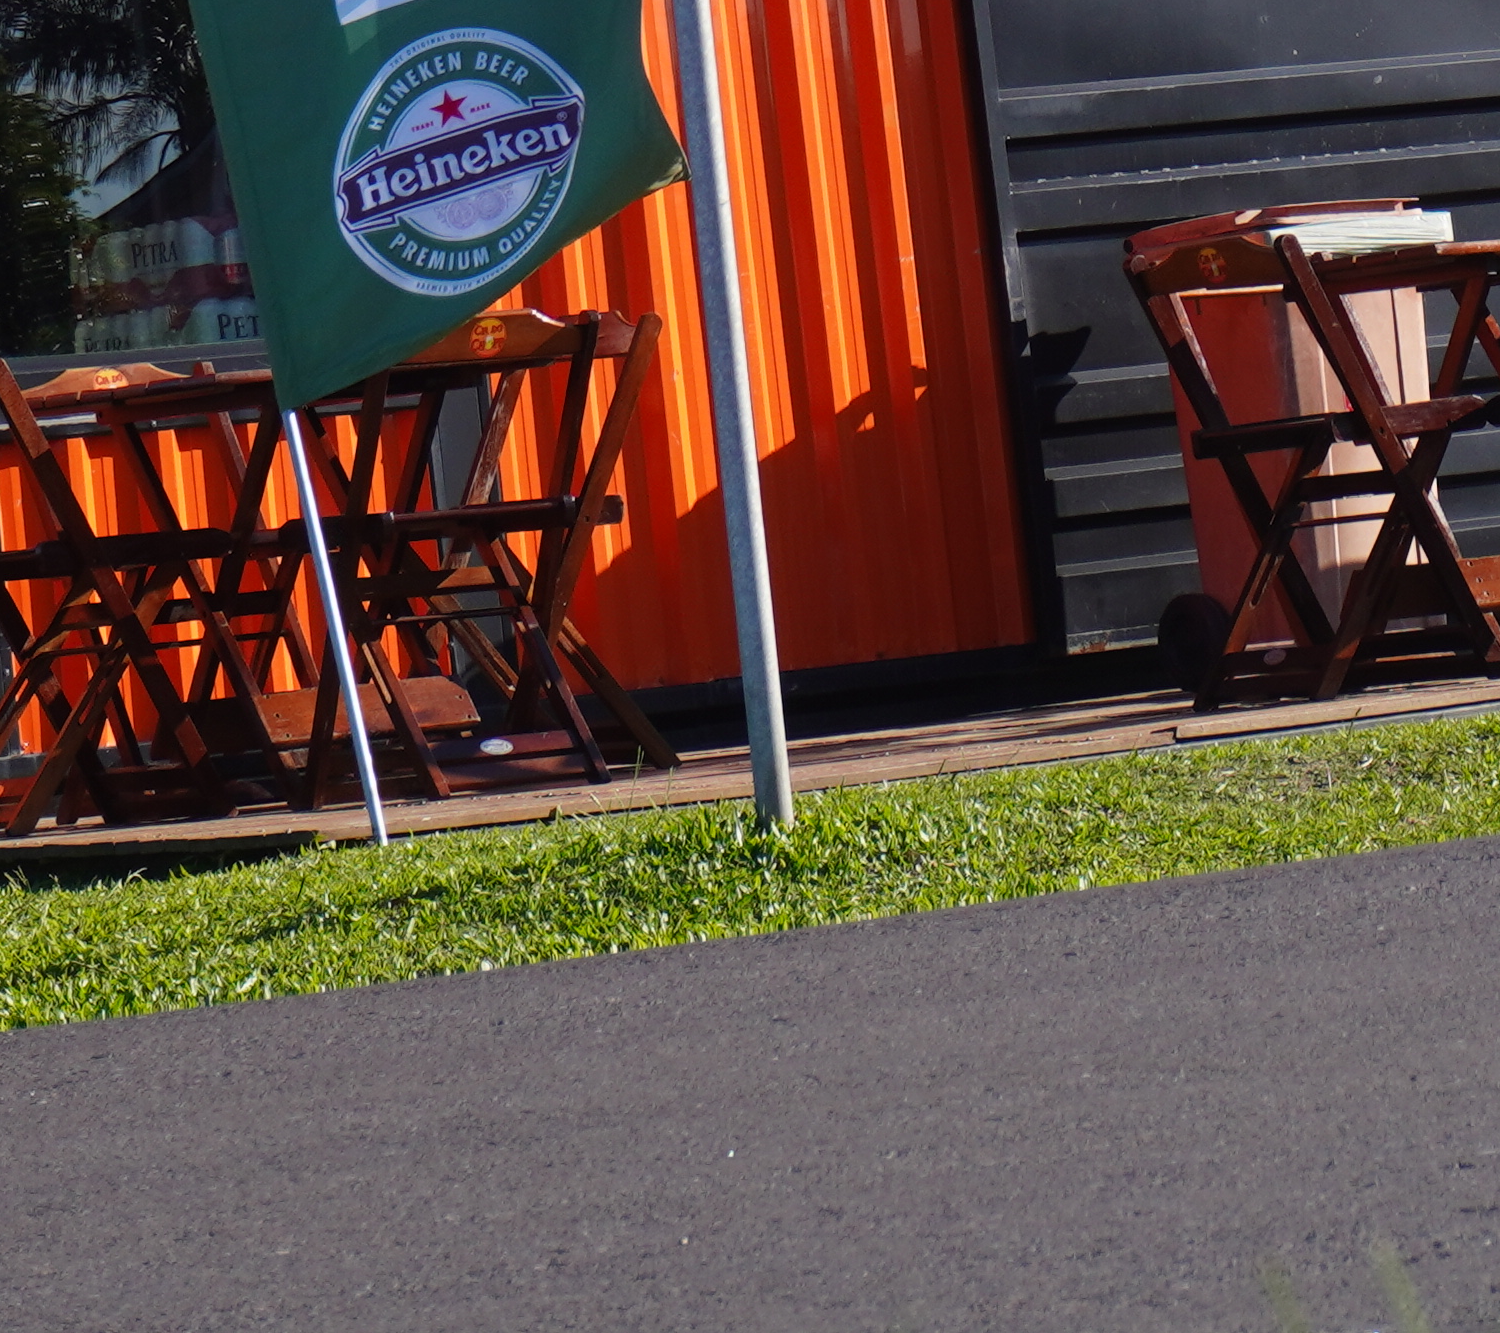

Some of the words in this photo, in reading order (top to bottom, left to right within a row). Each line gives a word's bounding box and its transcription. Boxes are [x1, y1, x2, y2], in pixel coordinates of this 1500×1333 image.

[368, 51, 463, 131] HEINEKEN
[474, 51, 530, 86] BEER
[356, 122, 573, 212] Heineken
[131, 239, 179, 270] PETRA
[388, 232, 490, 272] PREMIUM
[497, 178, 562, 255] QUALITY
[216, 305, 260, 342] PET
